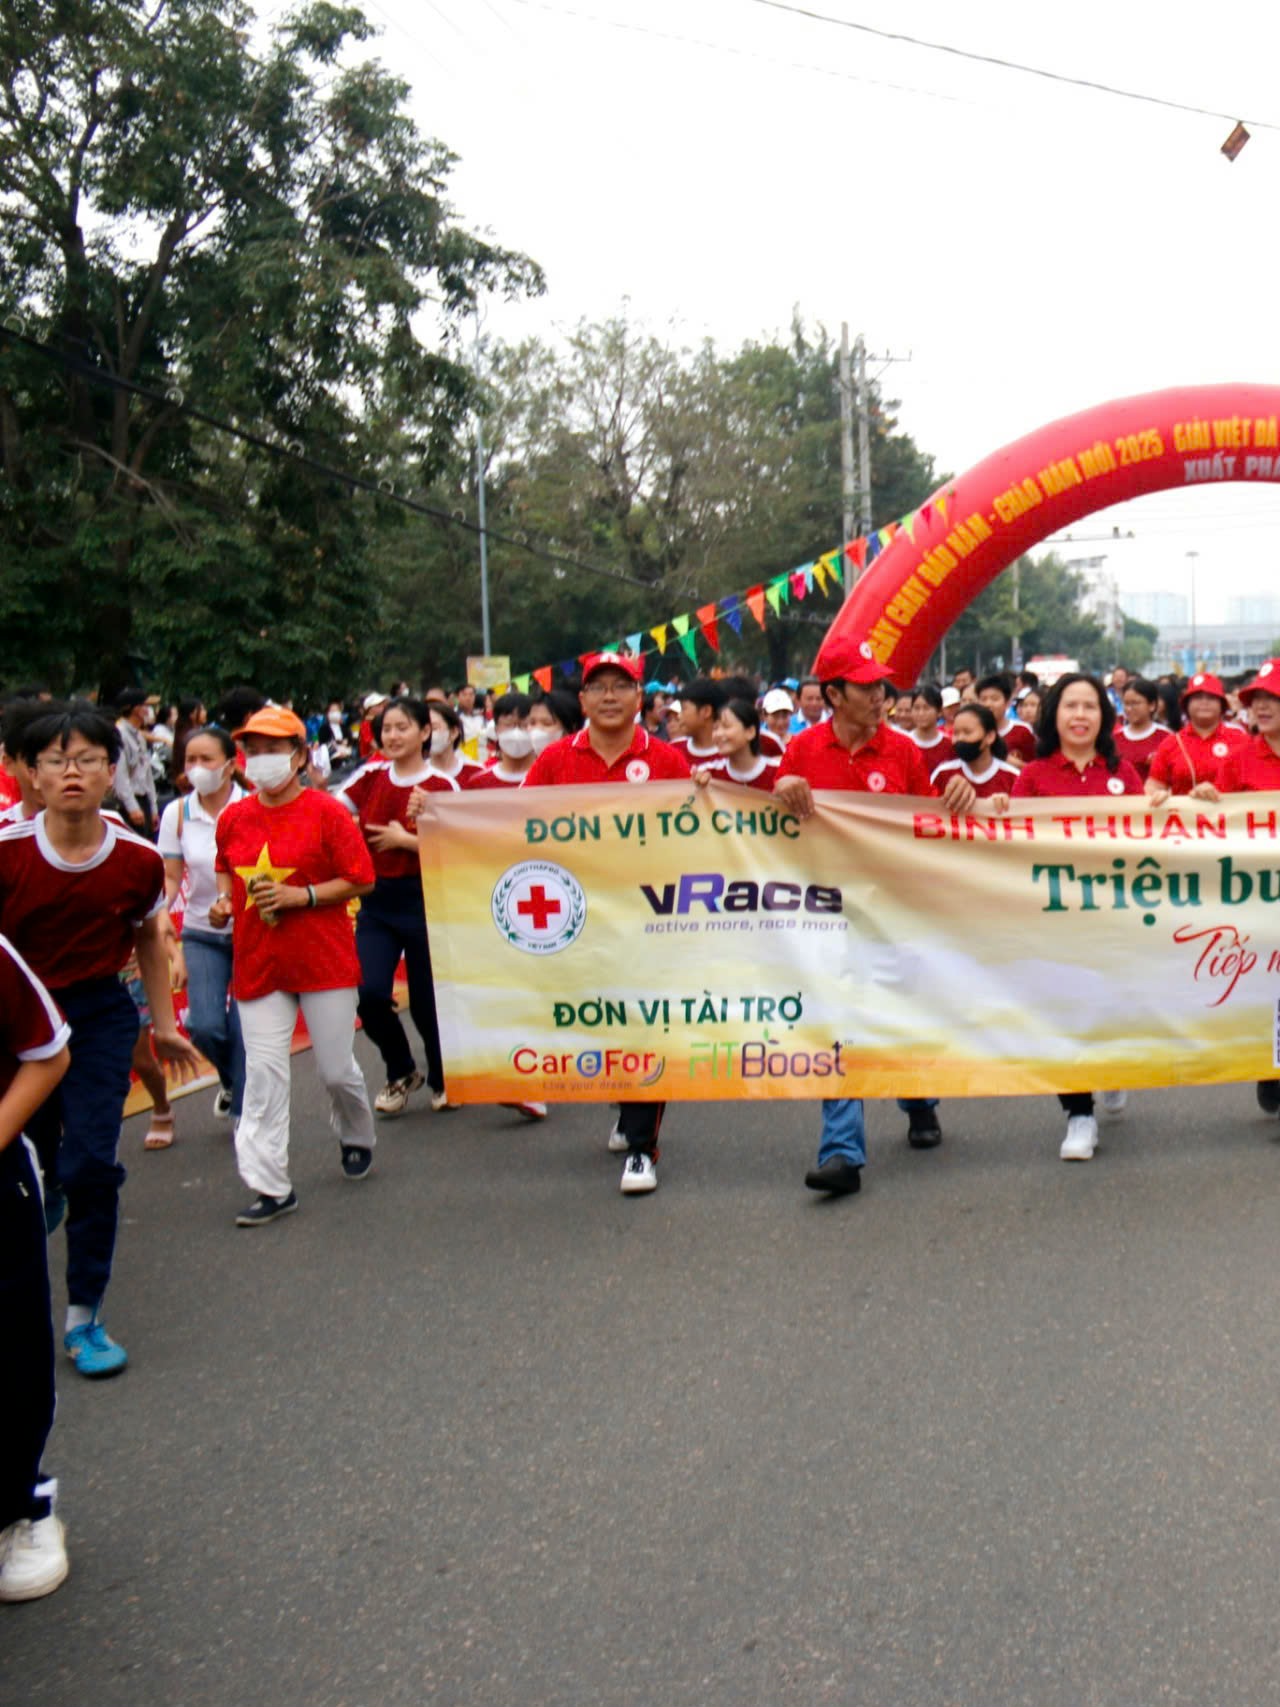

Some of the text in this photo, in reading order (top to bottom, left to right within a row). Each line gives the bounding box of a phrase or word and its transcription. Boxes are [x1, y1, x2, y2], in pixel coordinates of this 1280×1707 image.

[1184, 450, 1236, 481] XUẤT
[867, 617, 902, 666] GÀY
[993, 477, 1042, 523] CHÀO
[1115, 428, 1164, 466] 2025
[525, 796, 801, 845] ĐƠN VỊ TỔ CHỨC
[1051, 808, 1227, 845] THUẬN
[640, 873, 843, 915] vRace
[1031, 857, 1203, 926] Triệu
[645, 918, 848, 934] active more, race more
[1172, 923, 1258, 1008] Tiếp
[553, 989, 802, 1033] ĐƠN VỊ TÀI TRỢ
[513, 1048, 656, 1078] CareFor
